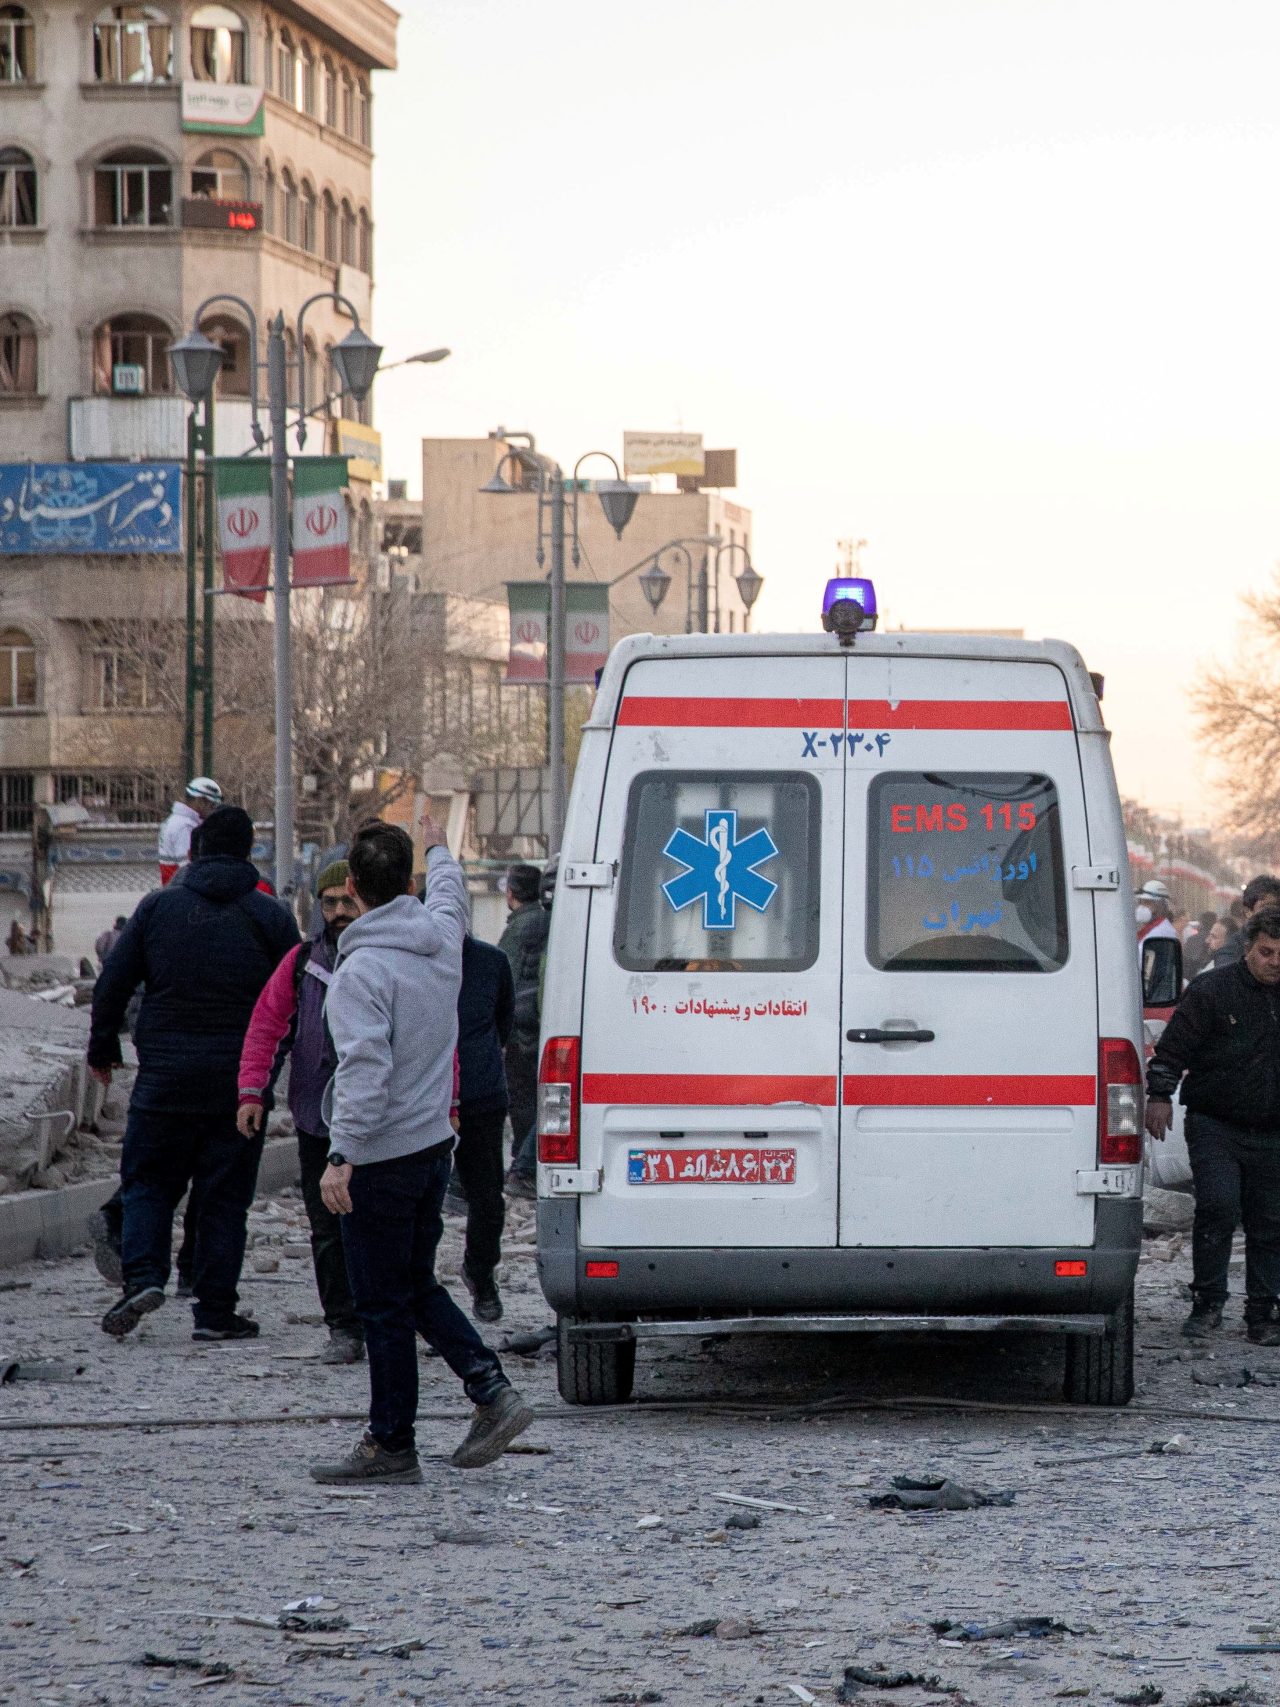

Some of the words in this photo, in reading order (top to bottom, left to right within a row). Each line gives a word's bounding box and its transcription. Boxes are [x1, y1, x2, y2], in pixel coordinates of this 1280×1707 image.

[111, 469, 173, 533] دفتر
[801, 731, 891, 758] X-۲۳۰۴
[891, 803, 969, 833] EMS
[980, 802, 1037, 832] 115
[891, 855, 935, 878] ۱۱۵
[922, 901, 1003, 932] تهران
[632, 995, 658, 1015] ۱۹۰
[675, 999, 740, 1021] پیشنهادات
[743, 1005, 751, 1020] و
[754, 999, 808, 1016] انتقادات
